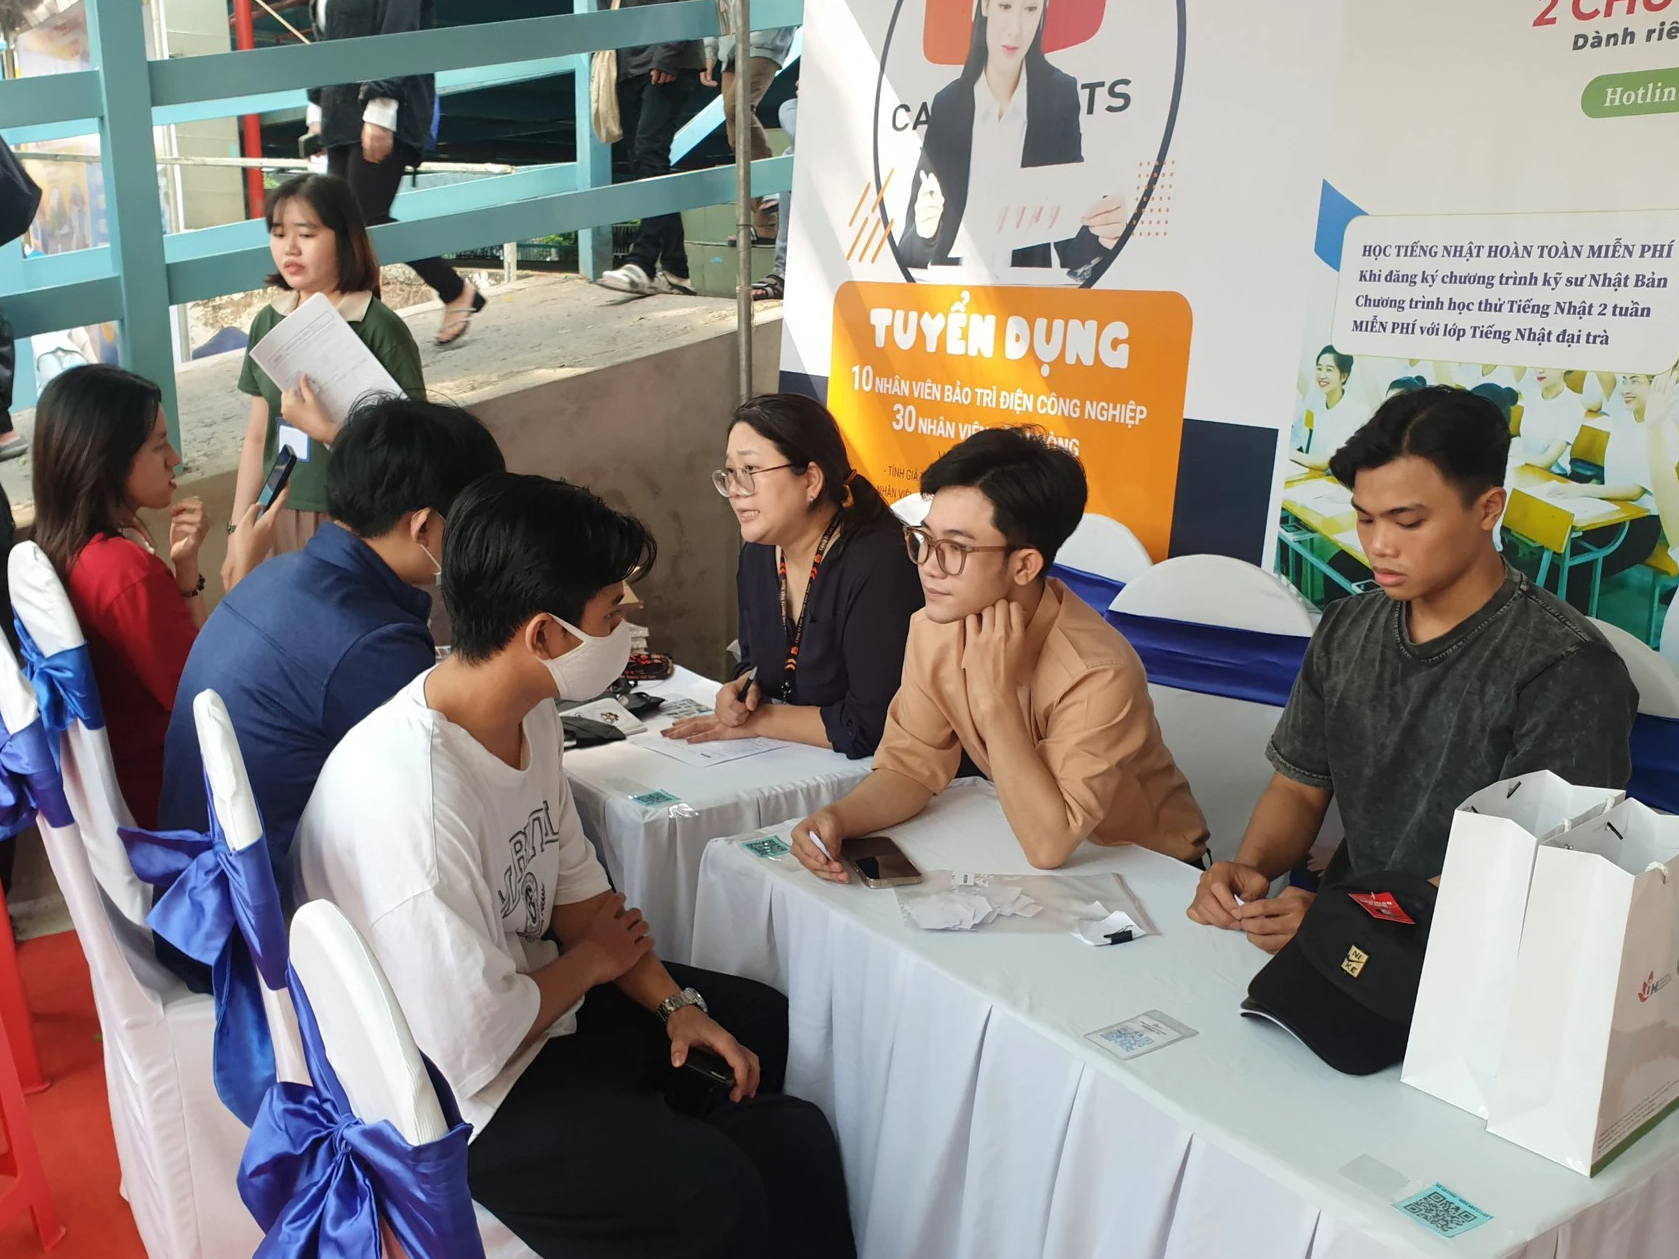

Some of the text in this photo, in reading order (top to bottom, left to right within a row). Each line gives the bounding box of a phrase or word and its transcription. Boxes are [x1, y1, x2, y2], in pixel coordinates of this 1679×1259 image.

[1572, 27, 1635, 51] Dành
[892, 78, 1132, 132] CA TS
[1604, 82, 1679, 107] Hotlin
[1362, 238, 1675, 262] HỌC TIẾNG NHẬT HOÀN TOÀN MIỄN PHÍ
[1359, 269, 1668, 292] Khi đăng ký chương trình kỹ sư Nhật Bản
[1355, 295, 1651, 319] Chương trình học thử Tiếng Nhật 2 tuần
[869, 290, 1130, 377] TUYỂN DỤNG
[1352, 315, 1609, 347] MIỄN PHÍ với lớp Tiếng Nhật đại trà
[852, 365, 1148, 428] 10 NHÂN VIÊN BẢO TRÌ ĐIỆN CÔNG NGHIỆP
[892, 404, 916, 432] 30
[918, 416, 955, 439] NHÂN
[958, 420, 989, 440] VIÊ
[888, 464, 904, 478] TÍNH
[906, 468, 918, 481] GIÁ
